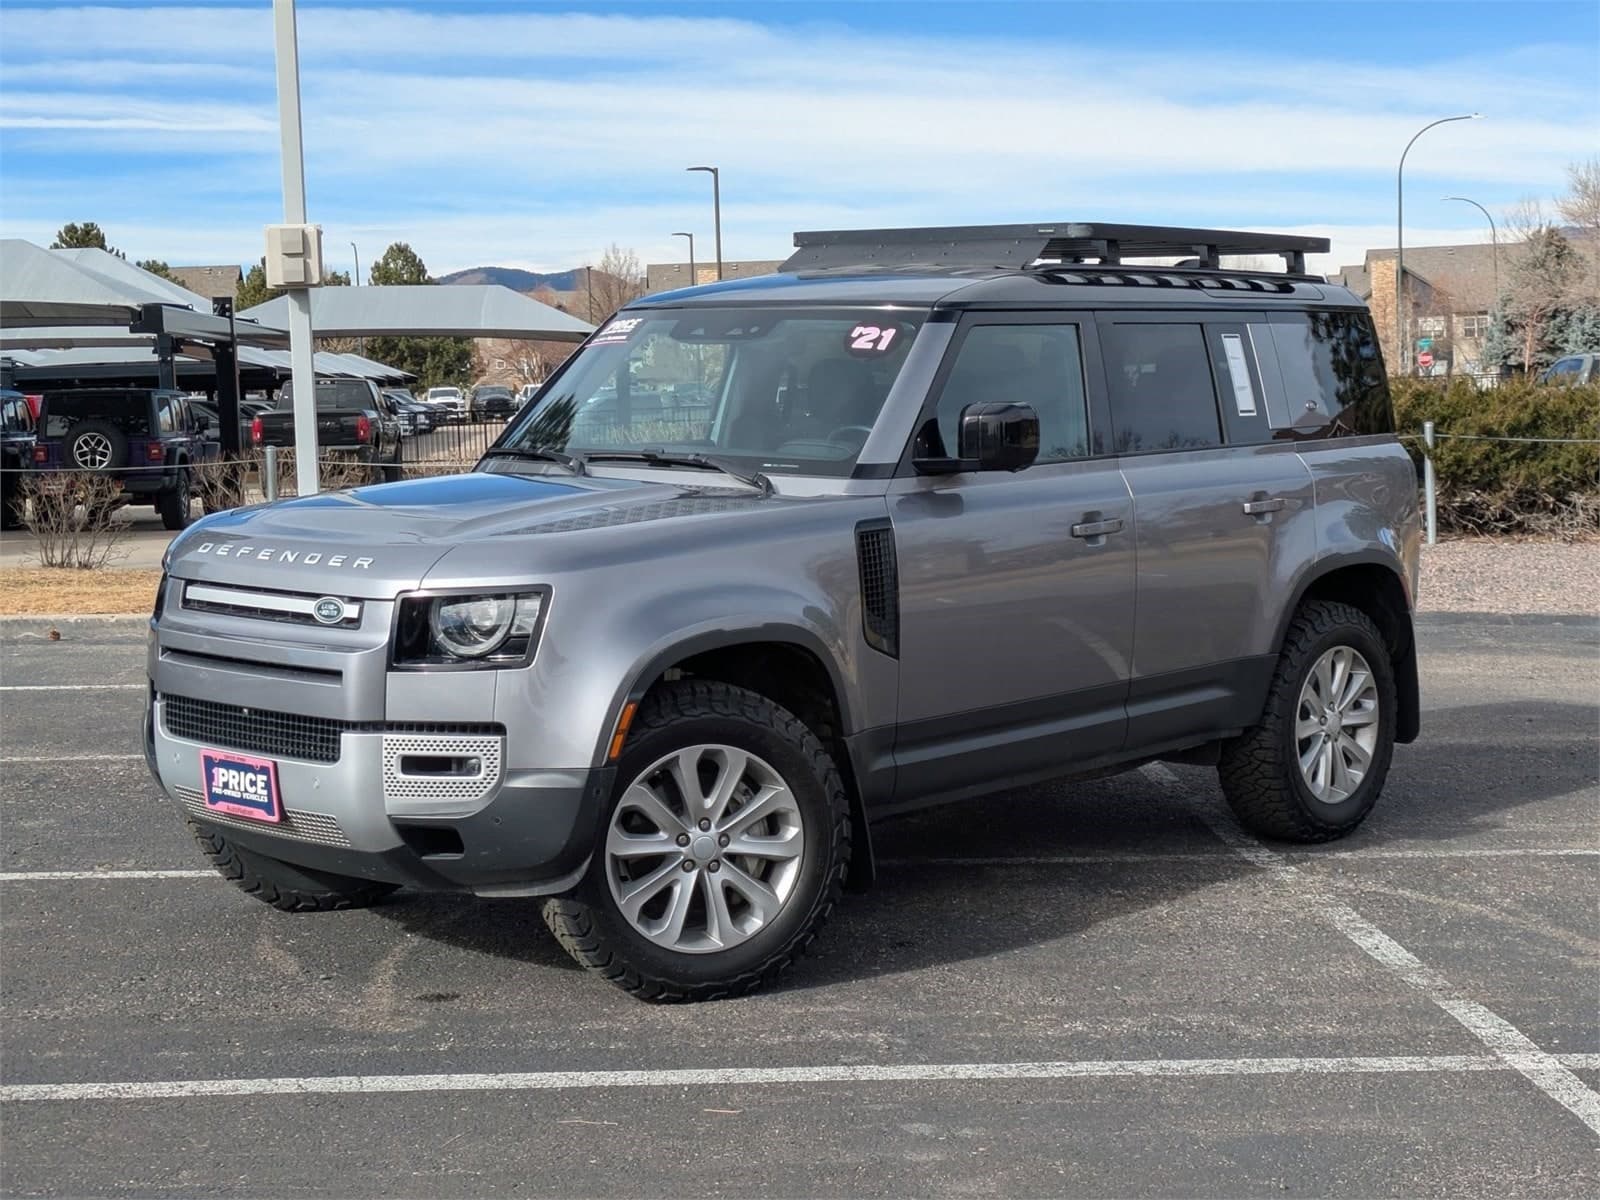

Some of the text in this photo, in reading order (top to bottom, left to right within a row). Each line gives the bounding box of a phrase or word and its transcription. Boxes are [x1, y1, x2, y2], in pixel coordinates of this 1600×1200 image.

[850, 326, 897, 351] '21
[197, 542, 375, 570] DEFENDER
[242, 791, 269, 803] VEHICLES
